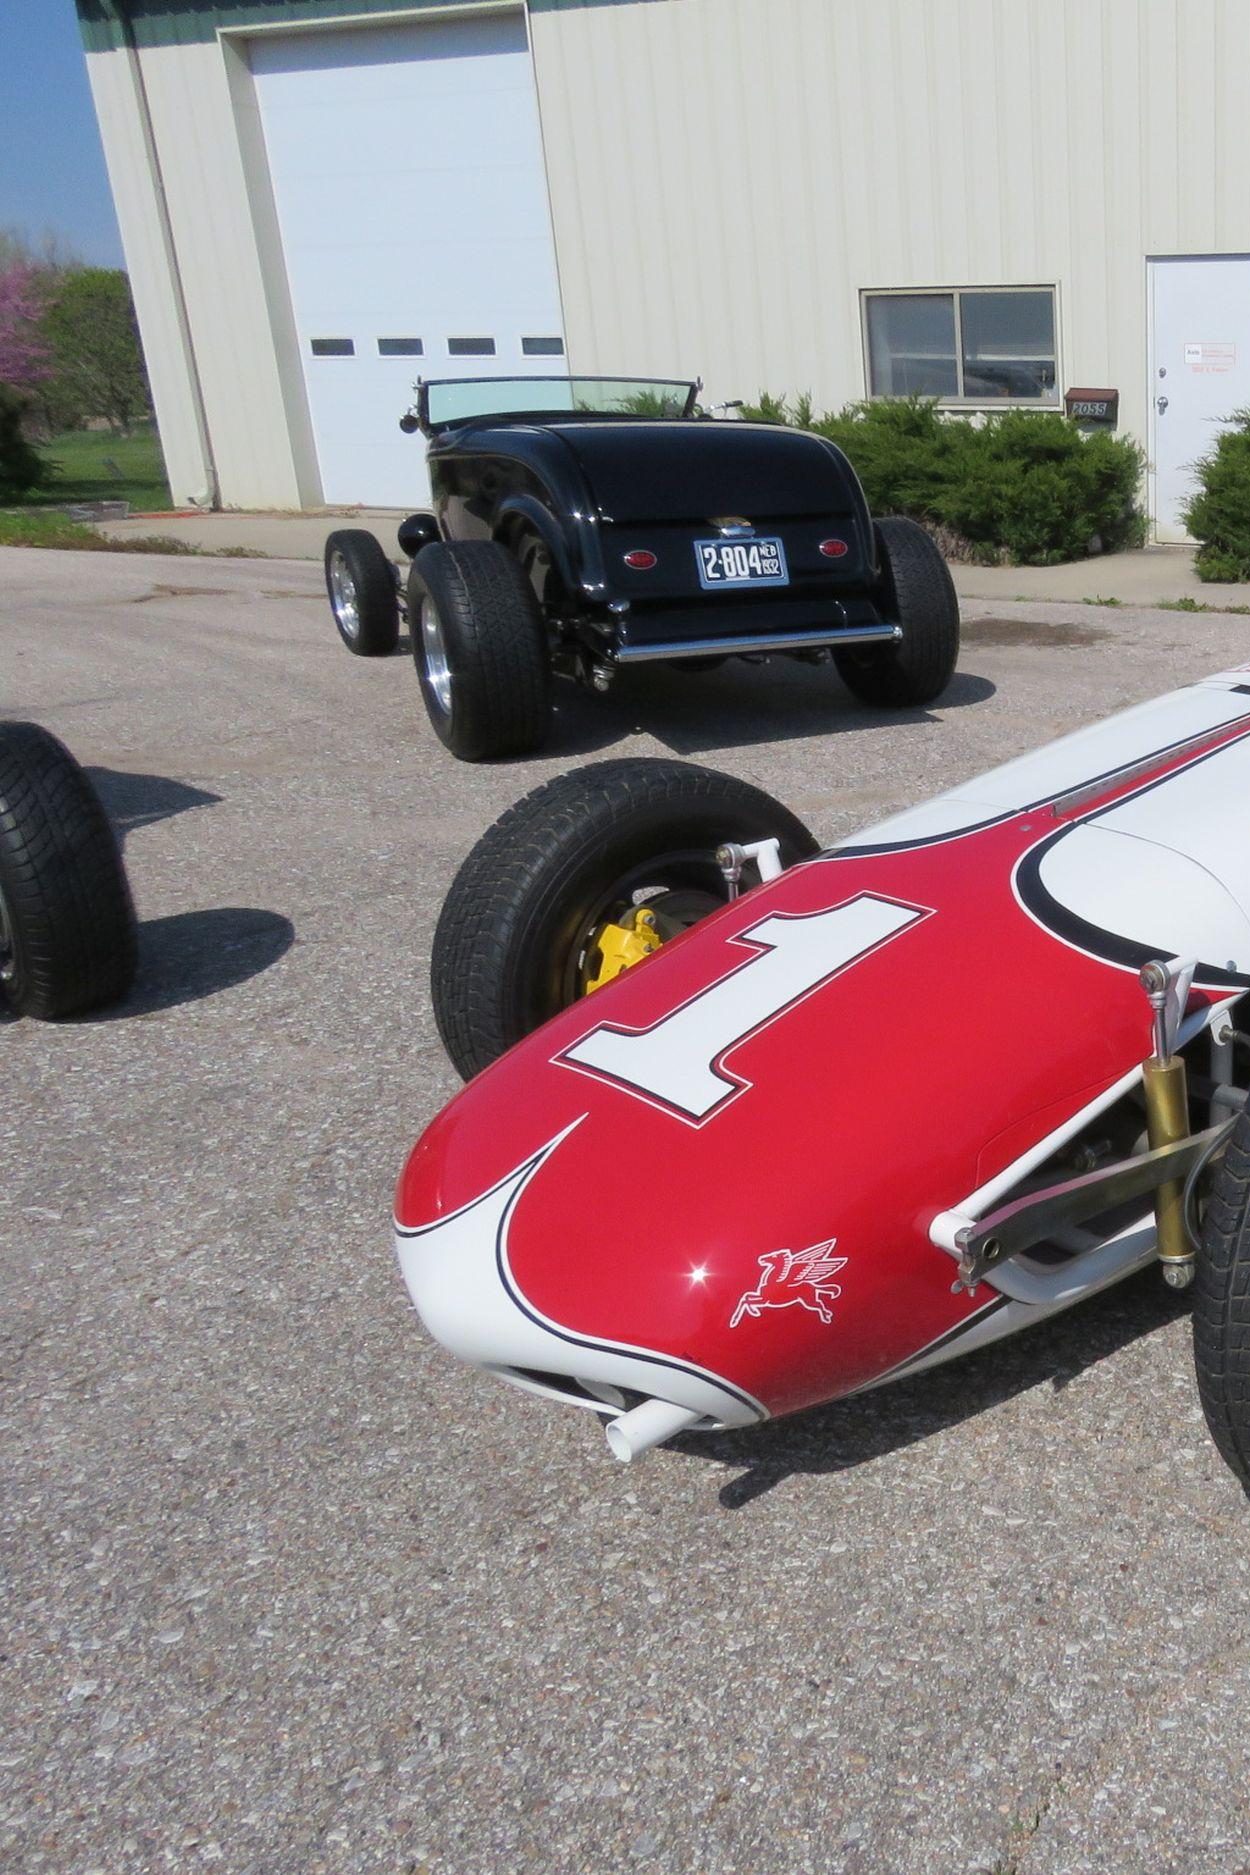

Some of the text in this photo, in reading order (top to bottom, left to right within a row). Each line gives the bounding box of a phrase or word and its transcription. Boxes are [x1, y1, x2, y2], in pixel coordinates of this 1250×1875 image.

[1073, 402, 1106, 415] 2055
[759, 545, 777, 557] NEB
[761, 558, 779, 575] 1932
[555, 892, 930, 1124] 1
